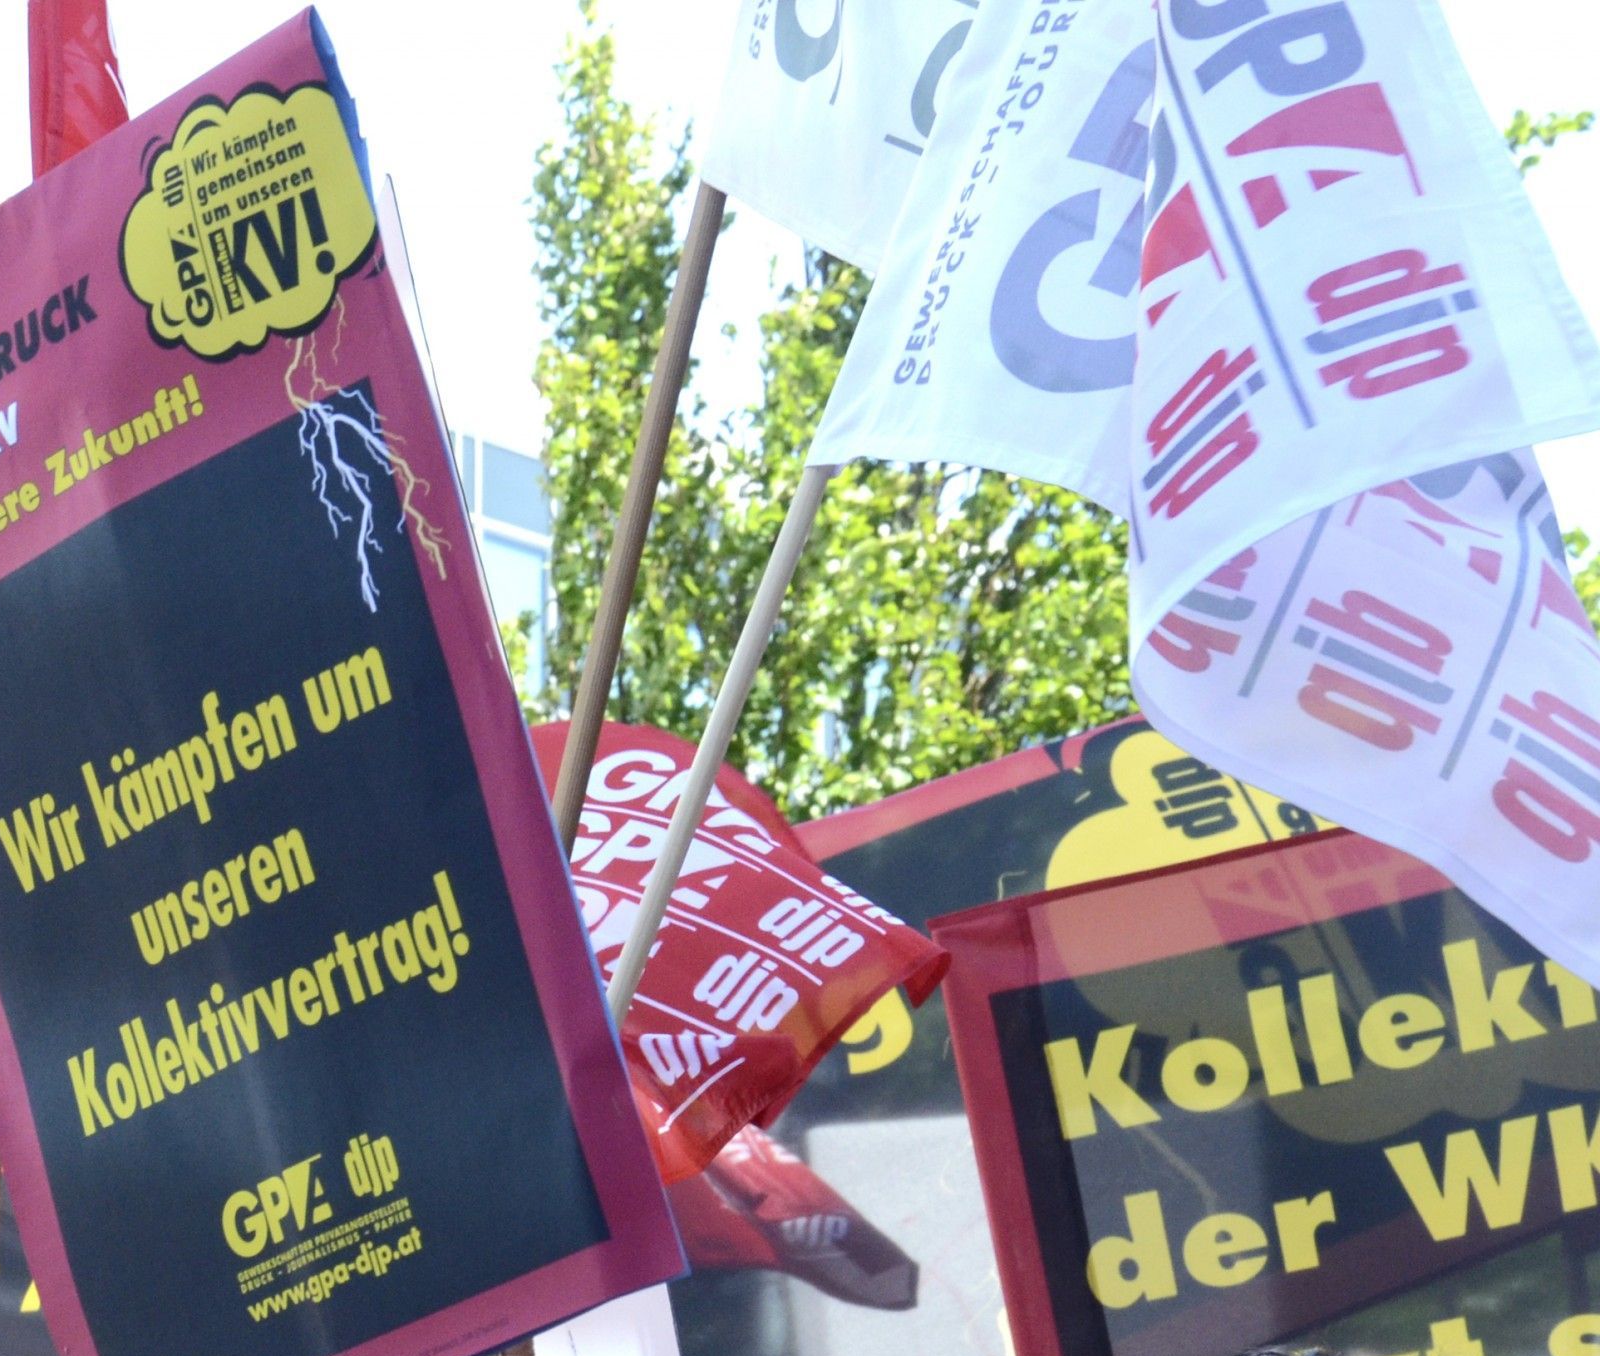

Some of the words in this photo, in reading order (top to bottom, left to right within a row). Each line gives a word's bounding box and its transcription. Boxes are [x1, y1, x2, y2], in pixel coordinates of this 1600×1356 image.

[191, 150, 218, 177] Wir
[223, 116, 298, 160] kämpfen
[197, 140, 307, 206] gemeinsam
[202, 202, 232, 226] um
[236, 166, 314, 211] unseren
[210, 187, 336, 314] KV!
[45, 373, 204, 498] Zukunft!
[82, 690, 298, 850] kämpfen
[301, 646, 393, 735] um
[130, 826, 316, 967] unseren
[758, 897, 865, 968] djp
[66, 870, 472, 1137] Kollektivvertrag!
[693, 950, 799, 1032] djp
[222, 1153, 334, 1259] GPA
[344, 1132, 400, 1198] djp
[374, 1208, 413, 1233] PAPIER
[1087, 1187, 1337, 1310] der
[247, 1226, 423, 1322] www.gpa-djp.at
